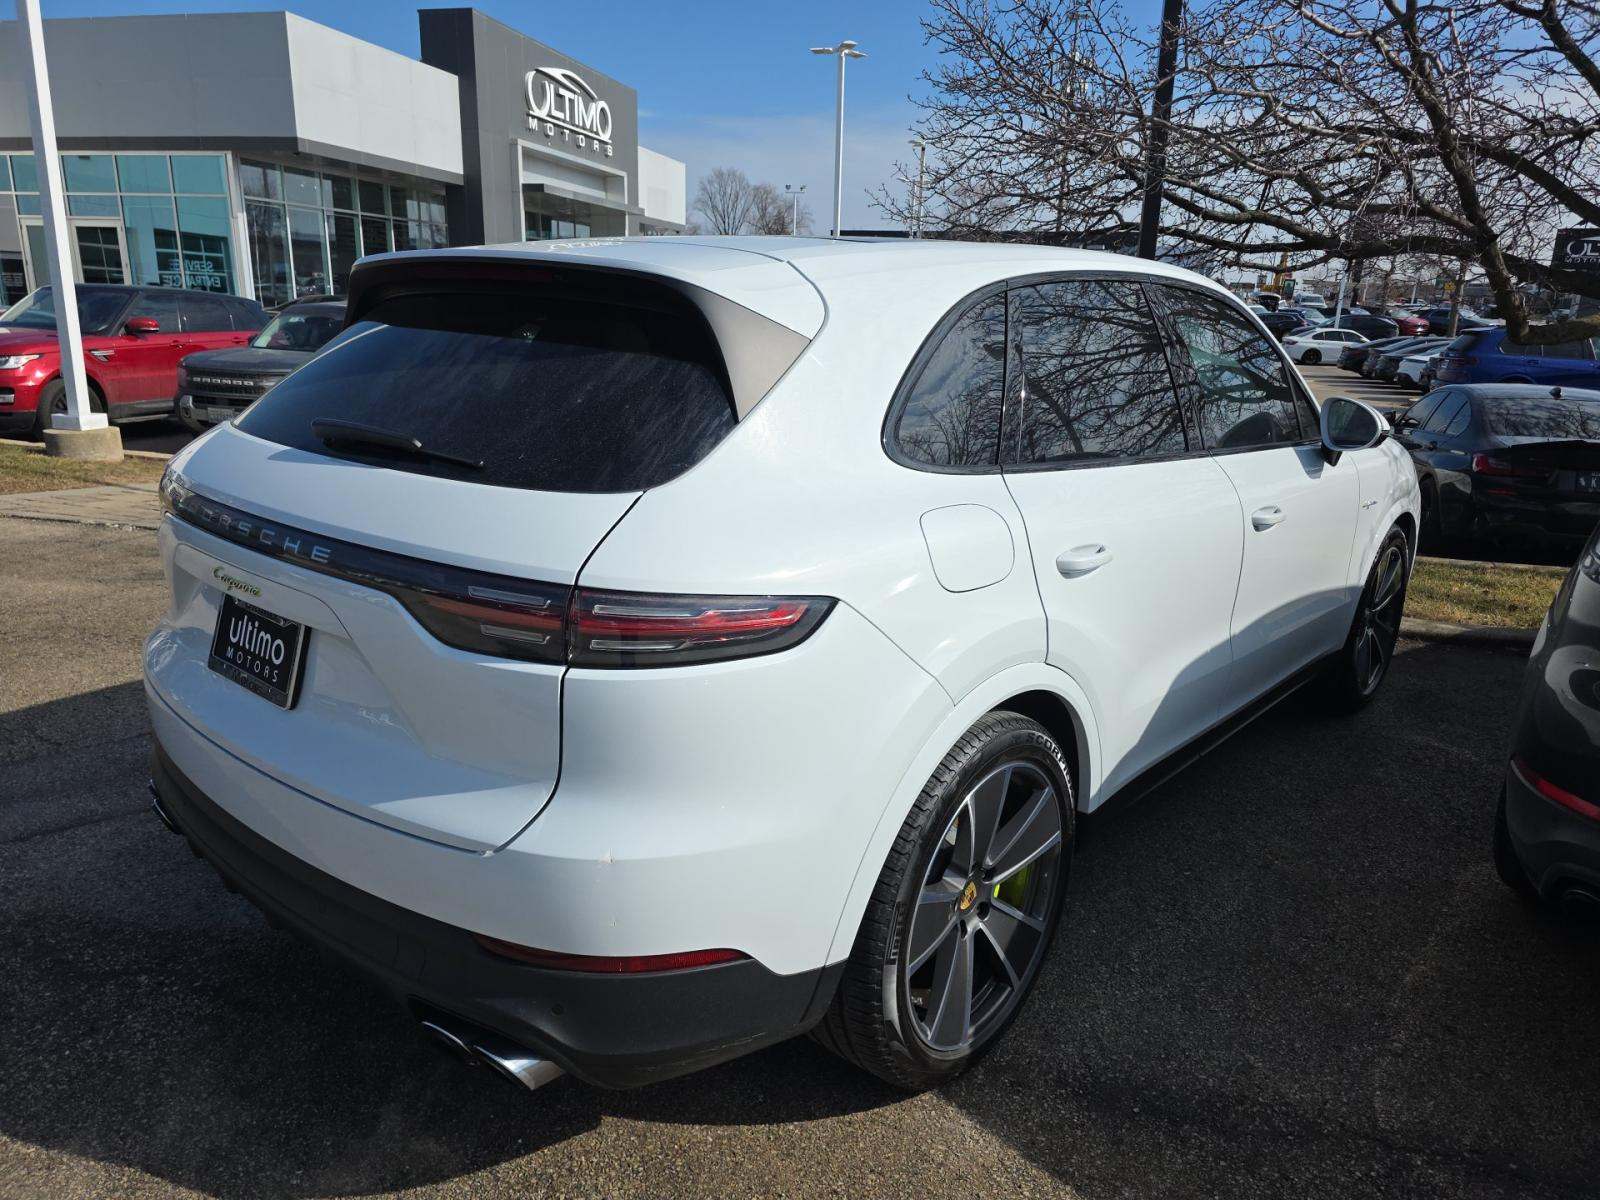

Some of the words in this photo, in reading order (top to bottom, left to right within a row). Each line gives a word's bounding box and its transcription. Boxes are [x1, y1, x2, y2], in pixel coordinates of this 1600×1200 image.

[525, 69, 612, 141] ULTIMO
[528, 117, 613, 157] MOTORS
[1566, 241, 1600, 257] UL
[190, 502, 332, 564] RSCHE
[229, 614, 285, 665] ultimo
[226, 646, 279, 683] MOTORS
